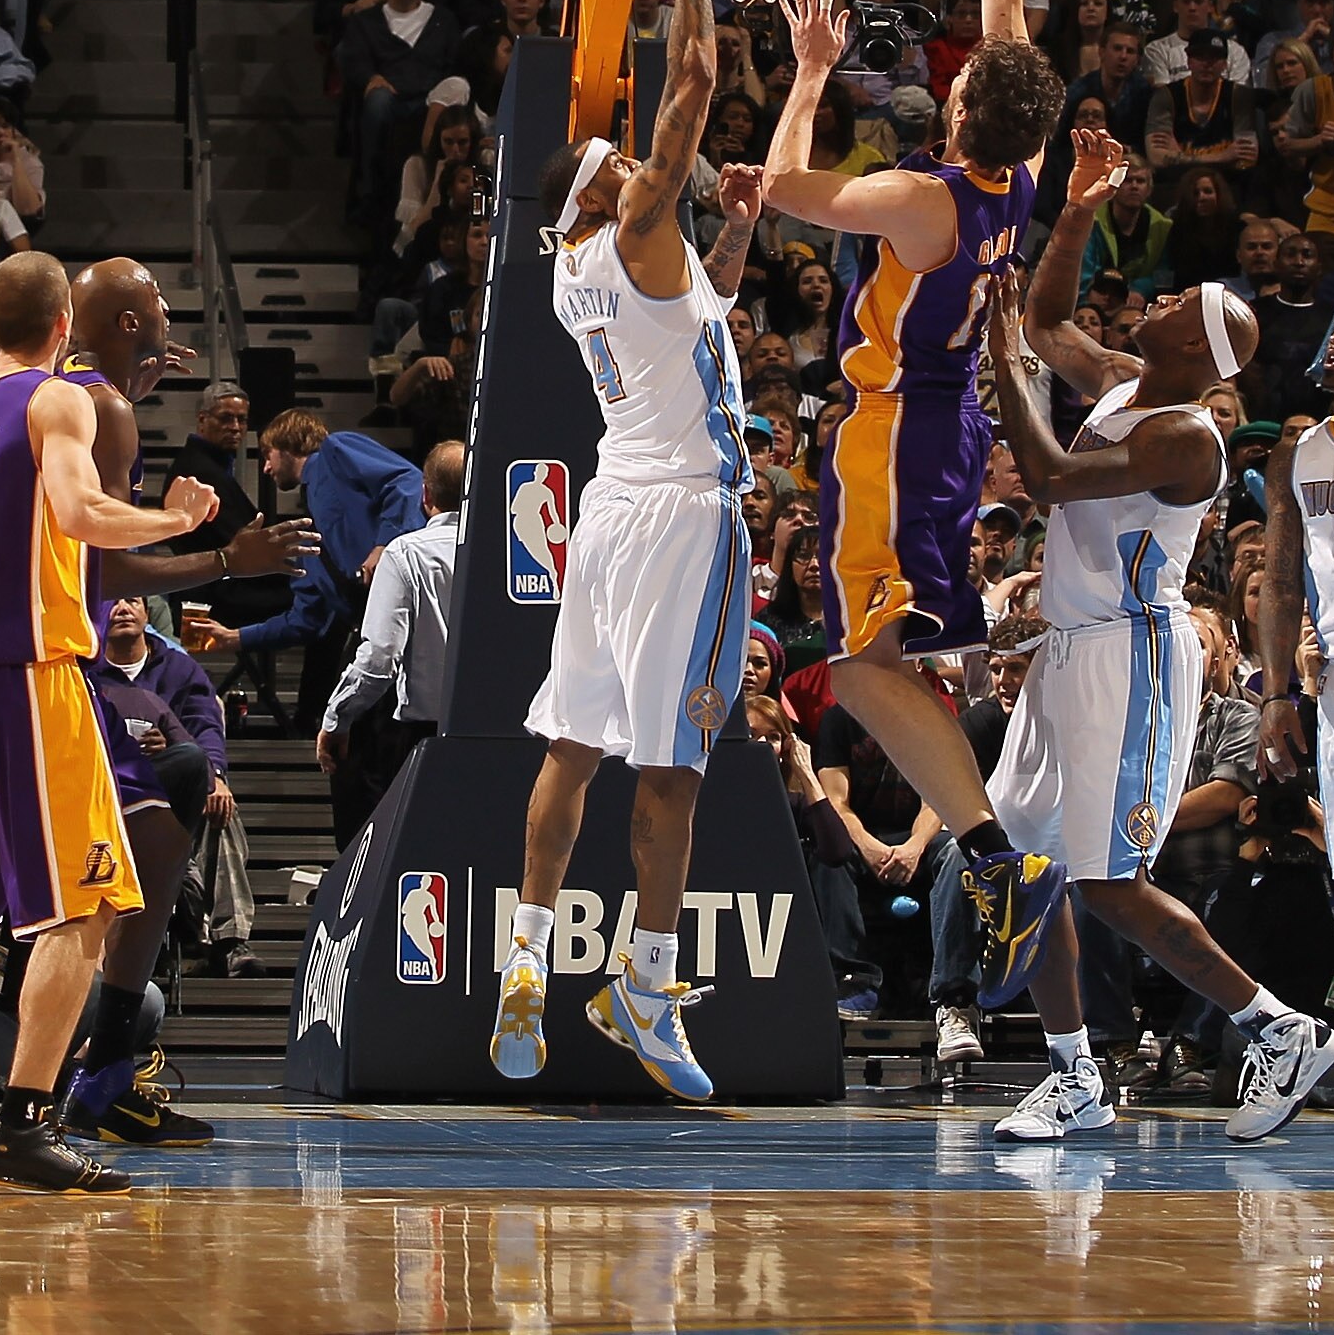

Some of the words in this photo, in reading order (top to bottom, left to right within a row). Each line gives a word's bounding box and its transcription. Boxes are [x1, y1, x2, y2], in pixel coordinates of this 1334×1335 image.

[587, 326, 627, 404] 4
[514, 575, 551, 595] NBA
[681, 891, 794, 979] TV
[403, 960, 430, 978] NBA
